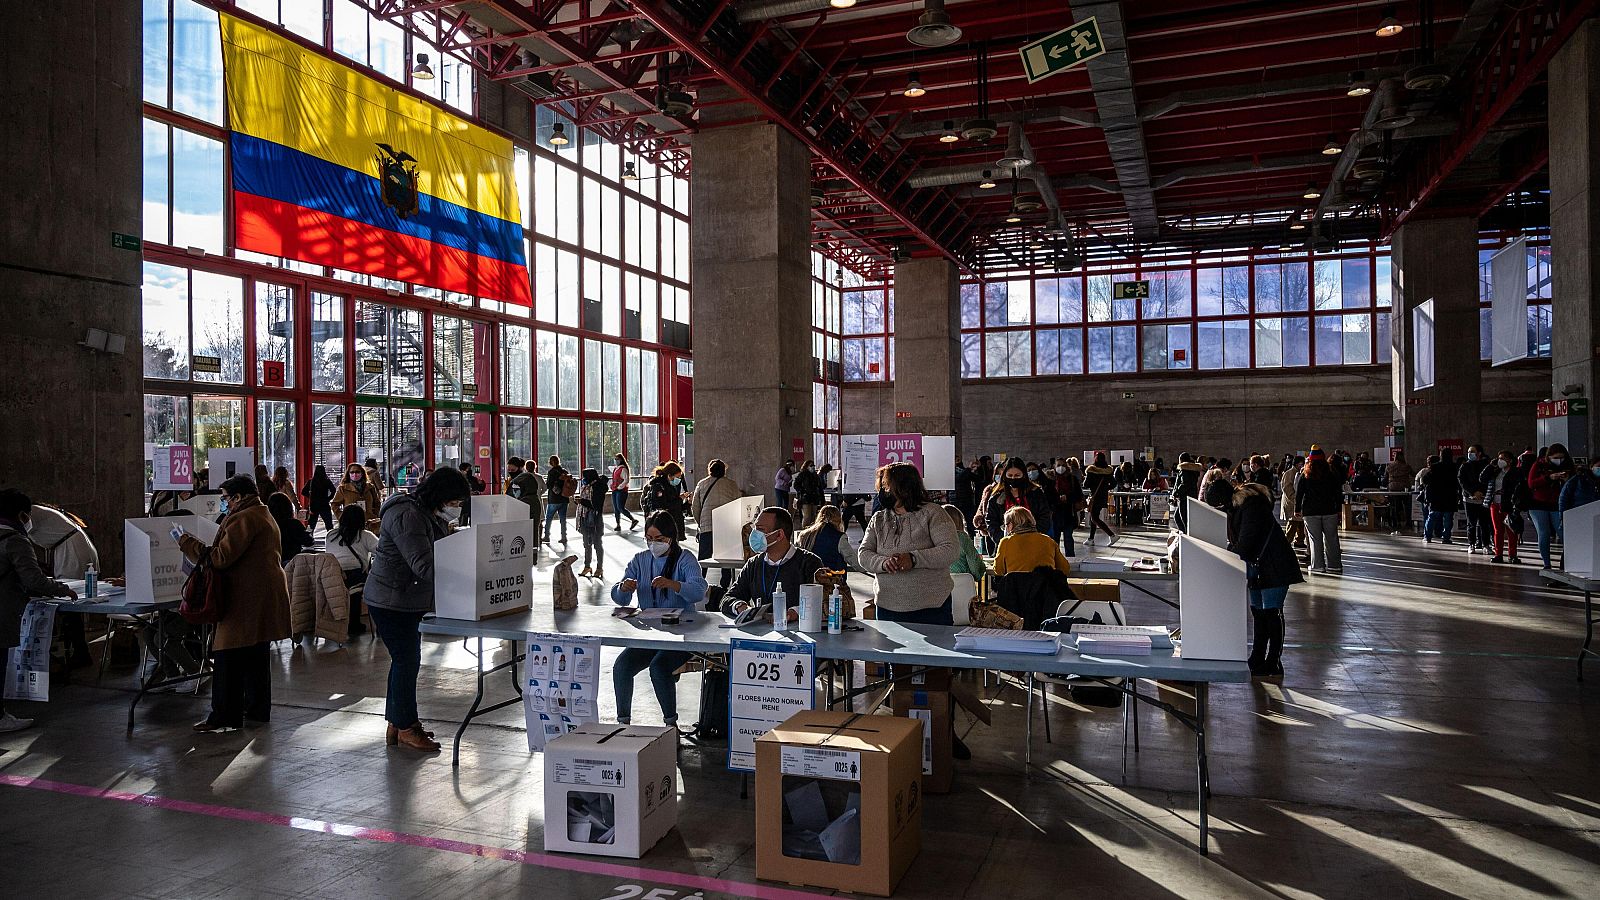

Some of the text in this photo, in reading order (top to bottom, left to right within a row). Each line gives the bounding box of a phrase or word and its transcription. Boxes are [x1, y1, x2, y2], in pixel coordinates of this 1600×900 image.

[268, 367, 280, 381] B
[884, 440, 916, 450] JUNTA
[174, 460, 188, 476] 26
[485, 575, 524, 591] EL VOTO ES
[490, 589, 521, 604] SECRETO
[747, 662, 780, 681] 025
[602, 770, 613, 780] 0025
